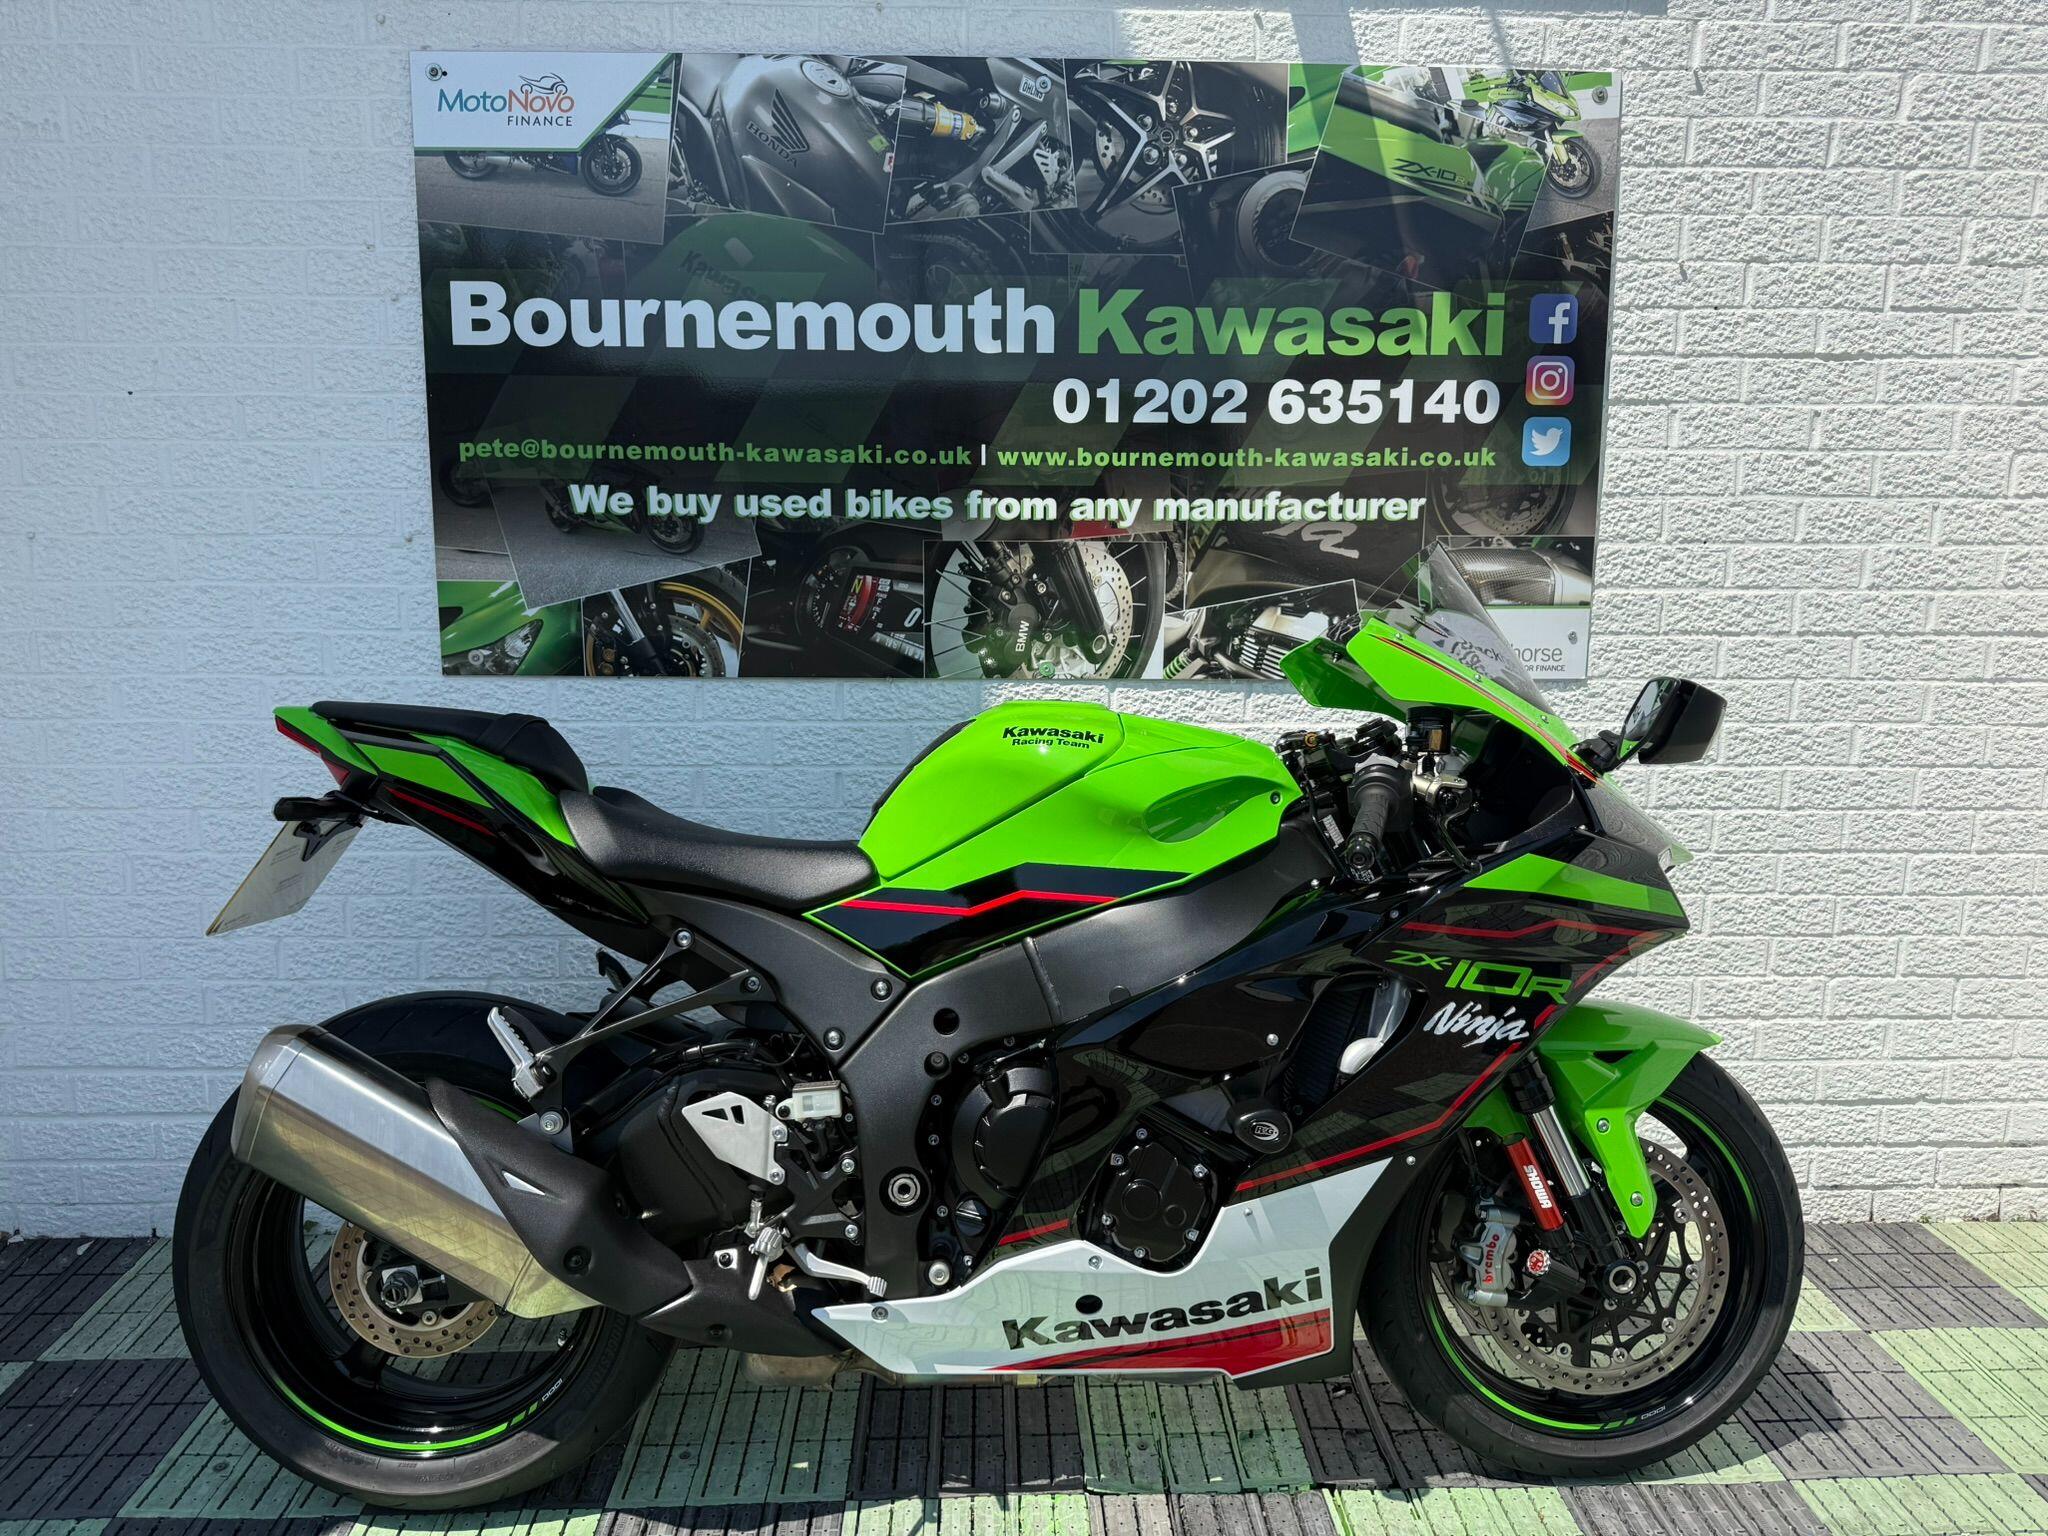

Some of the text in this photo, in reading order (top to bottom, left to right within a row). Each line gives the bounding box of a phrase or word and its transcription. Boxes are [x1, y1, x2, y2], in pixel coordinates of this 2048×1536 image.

[437, 88, 576, 114] MotoNovo
[507, 115, 573, 127] FINANCE
[747, 121, 799, 168] HONDA
[449, 280, 1506, 357] Bournemouth Kawasaki
[1052, 378, 1500, 425] 01202 635140
[458, 438, 973, 467] pete@bournemouth-kawasaki.co.uk
[997, 447, 1497, 469] www.bournemouth-kawasaki.co.uk
[569, 484, 1427, 530] We buy used bikes from any manufacturer
[1015, 620, 1030, 652] BMW
[1535, 664, 1566, 672] FINANCE
[1002, 725, 1105, 744] Kawasaki
[1012, 737, 1091, 750] Racing Team
[1422, 1000, 1530, 1048] Ninja
[1522, 1164, 1553, 1209] SHOWA
[1482, 1233, 1501, 1285] brembo
[1001, 1266, 1324, 1351] Kawasaki
